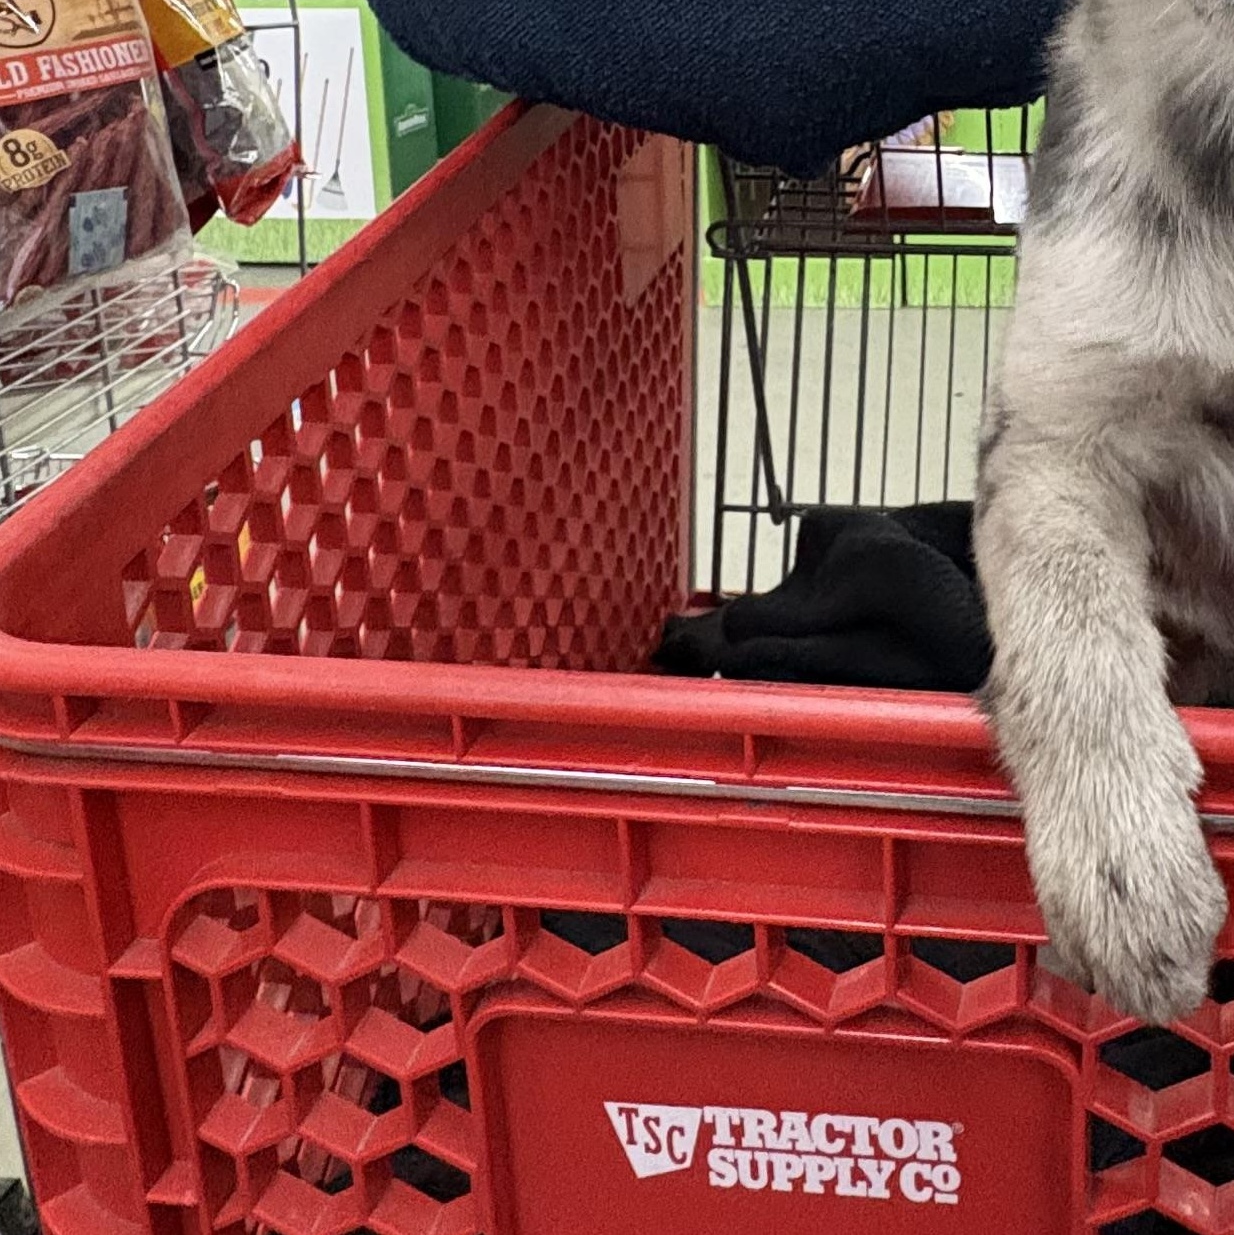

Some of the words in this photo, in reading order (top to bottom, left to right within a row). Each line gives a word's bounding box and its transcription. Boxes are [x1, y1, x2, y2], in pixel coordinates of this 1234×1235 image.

[0, 151, 68, 192] PROTEIN
[2, 138, 44, 167] 8g
[617, 1106, 689, 1164] TSC
[702, 1105, 958, 1162] TRACTOR
[706, 1147, 894, 1200] SUPPLY
